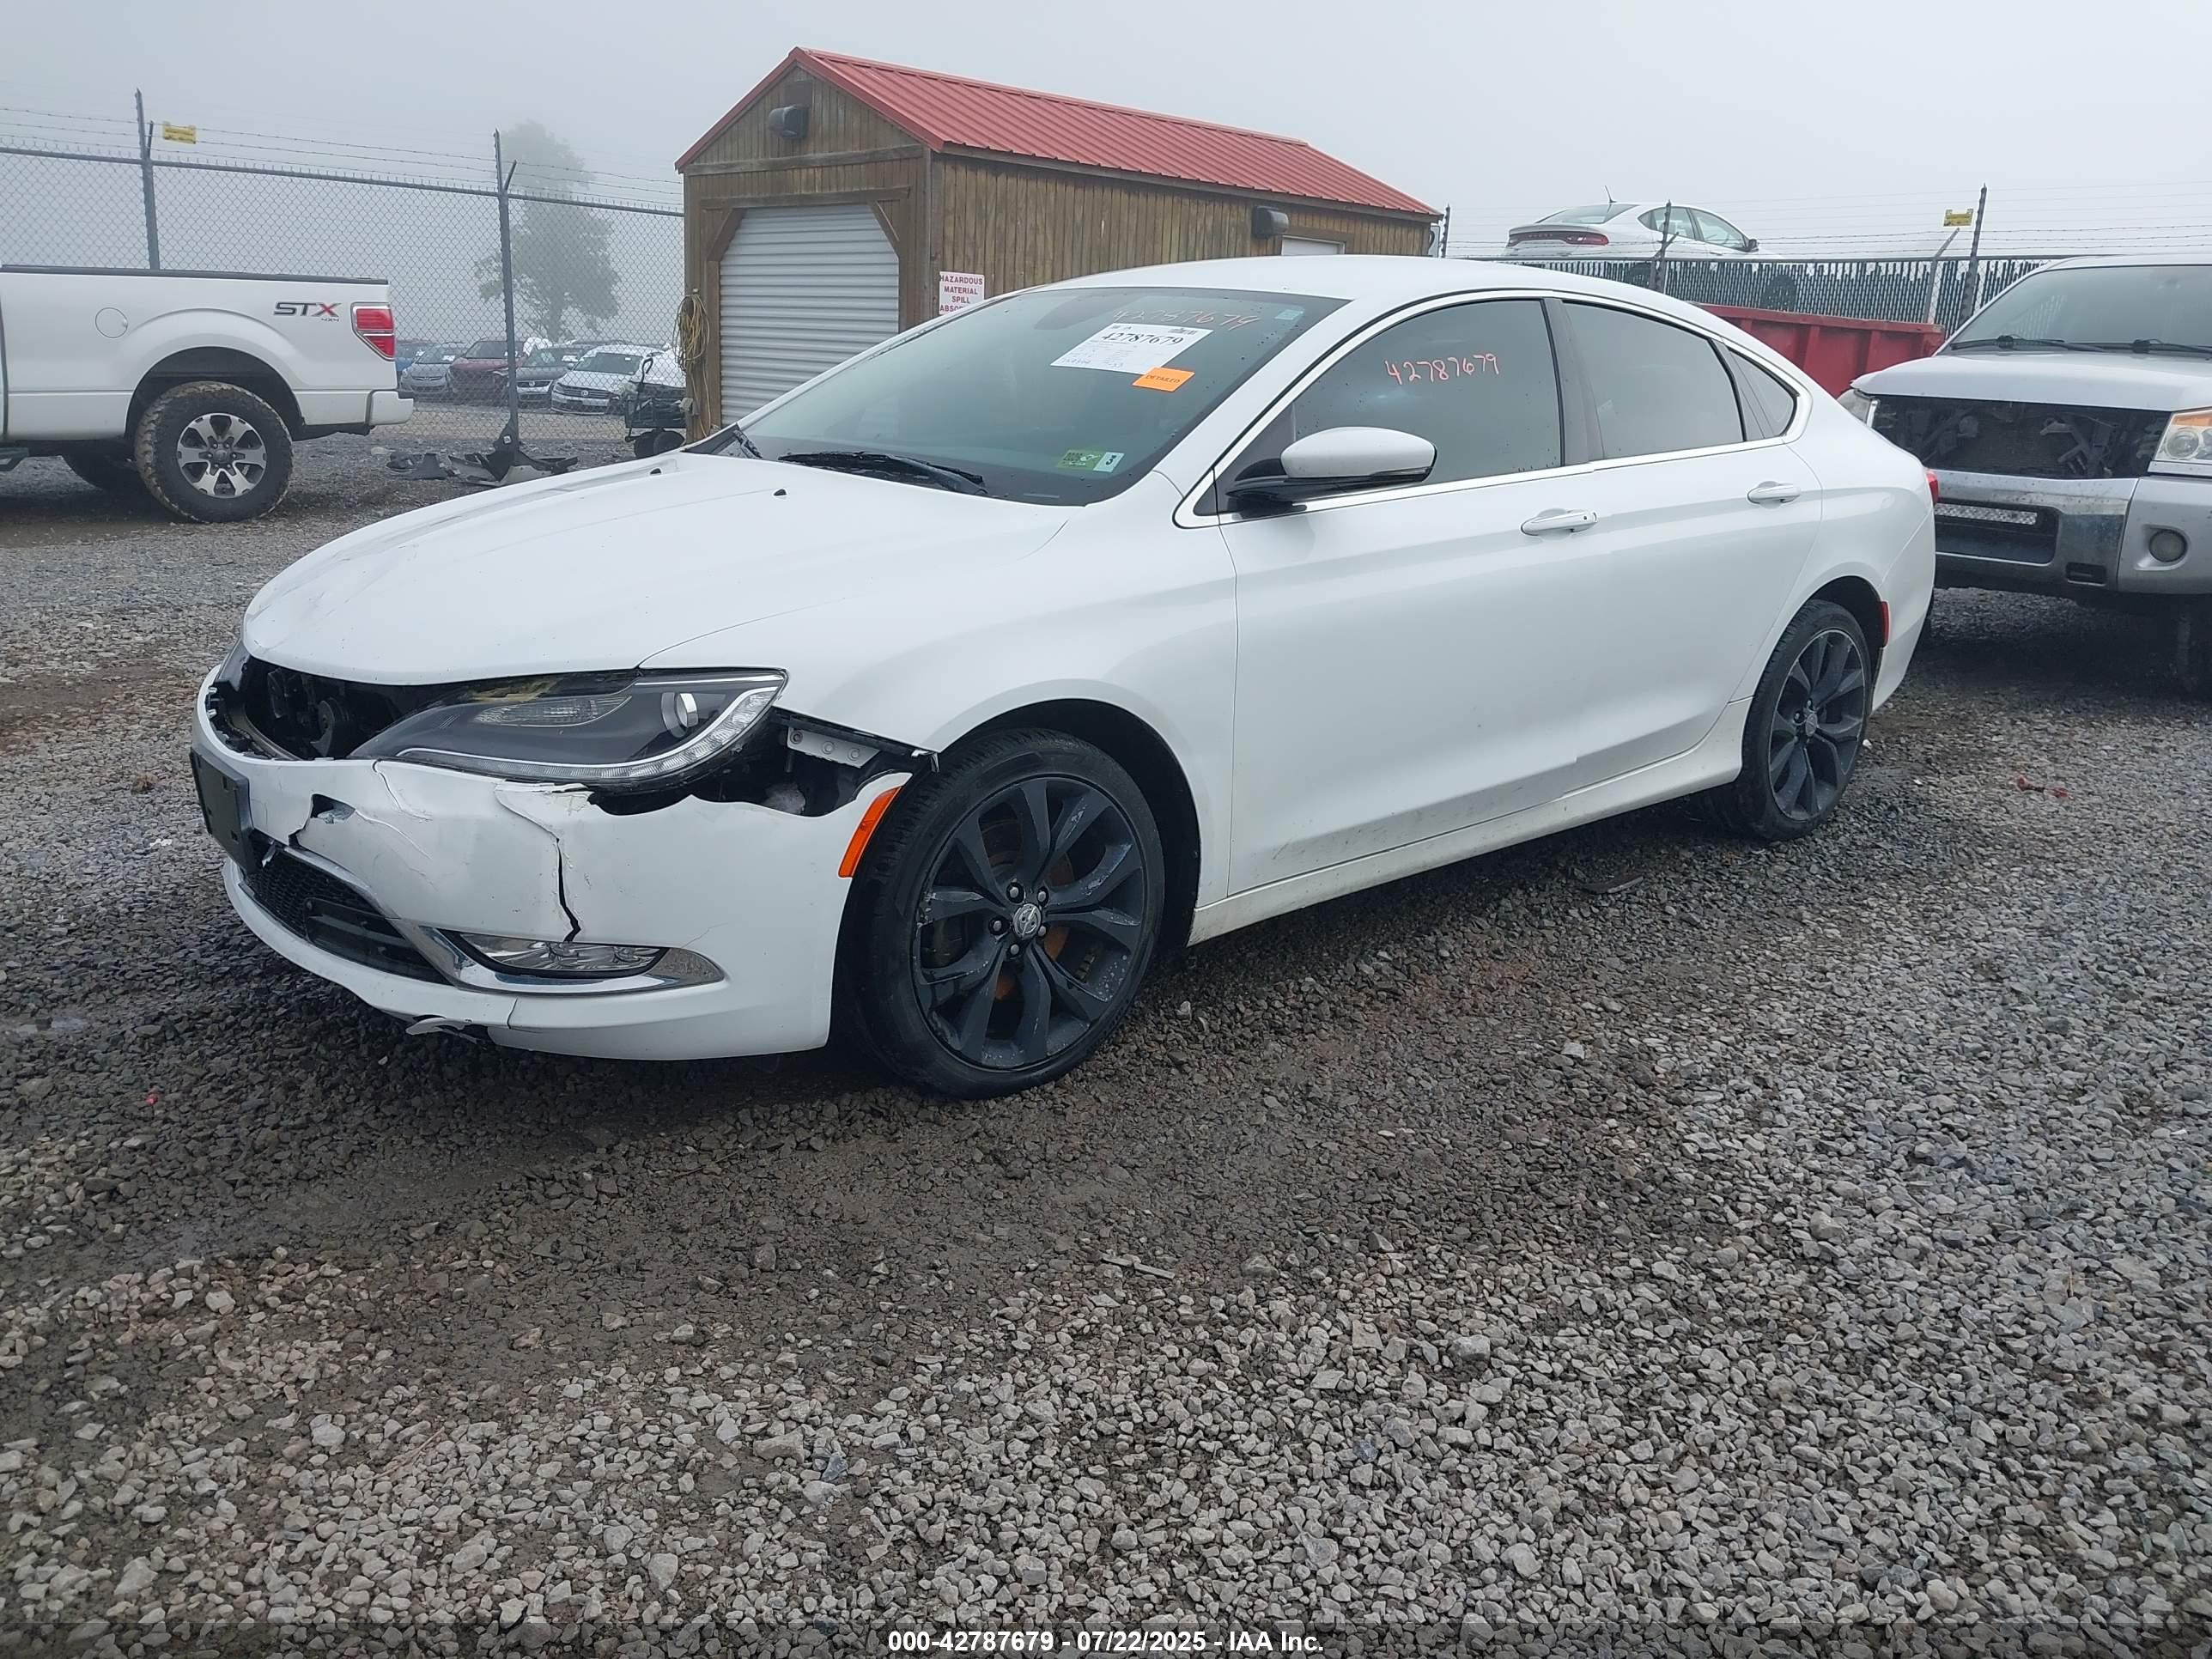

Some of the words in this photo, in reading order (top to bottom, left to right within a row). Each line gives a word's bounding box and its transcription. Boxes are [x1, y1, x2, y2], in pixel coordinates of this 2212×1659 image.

[940, 275, 983, 285] HAZARDOUS
[944, 286, 978, 295] MATERIAL
[273, 301, 342, 317] STX
[1101, 332, 1184, 346] 42787679
[1384, 353, 1499, 386] 42787679
[1105, 454, 1117, 466] 3
